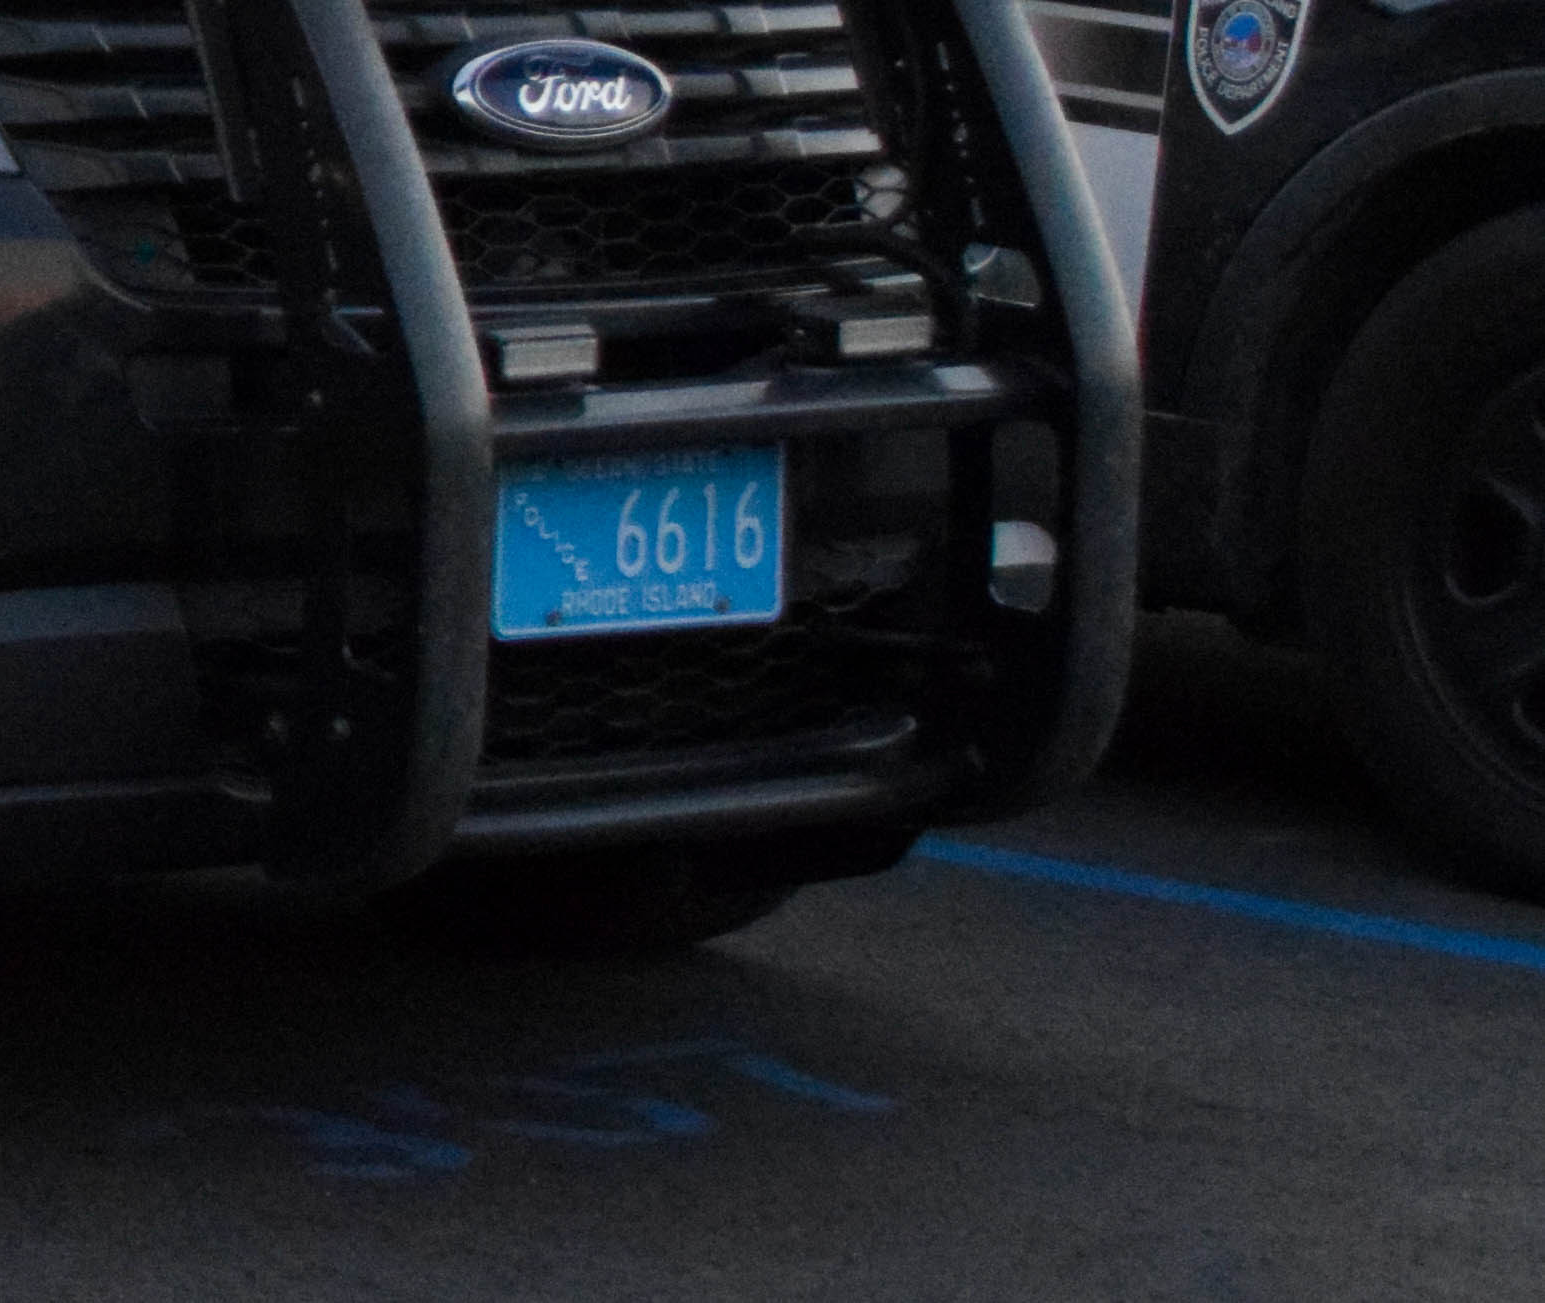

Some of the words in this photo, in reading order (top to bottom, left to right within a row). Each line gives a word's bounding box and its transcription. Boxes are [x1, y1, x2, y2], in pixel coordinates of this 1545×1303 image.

[518, 72, 632, 113] Ford
[515, 492, 589, 582] POLICE
[616, 481, 763, 578] 6616
[563, 587, 630, 615] RHODE
[641, 581, 717, 613] ISLAND
